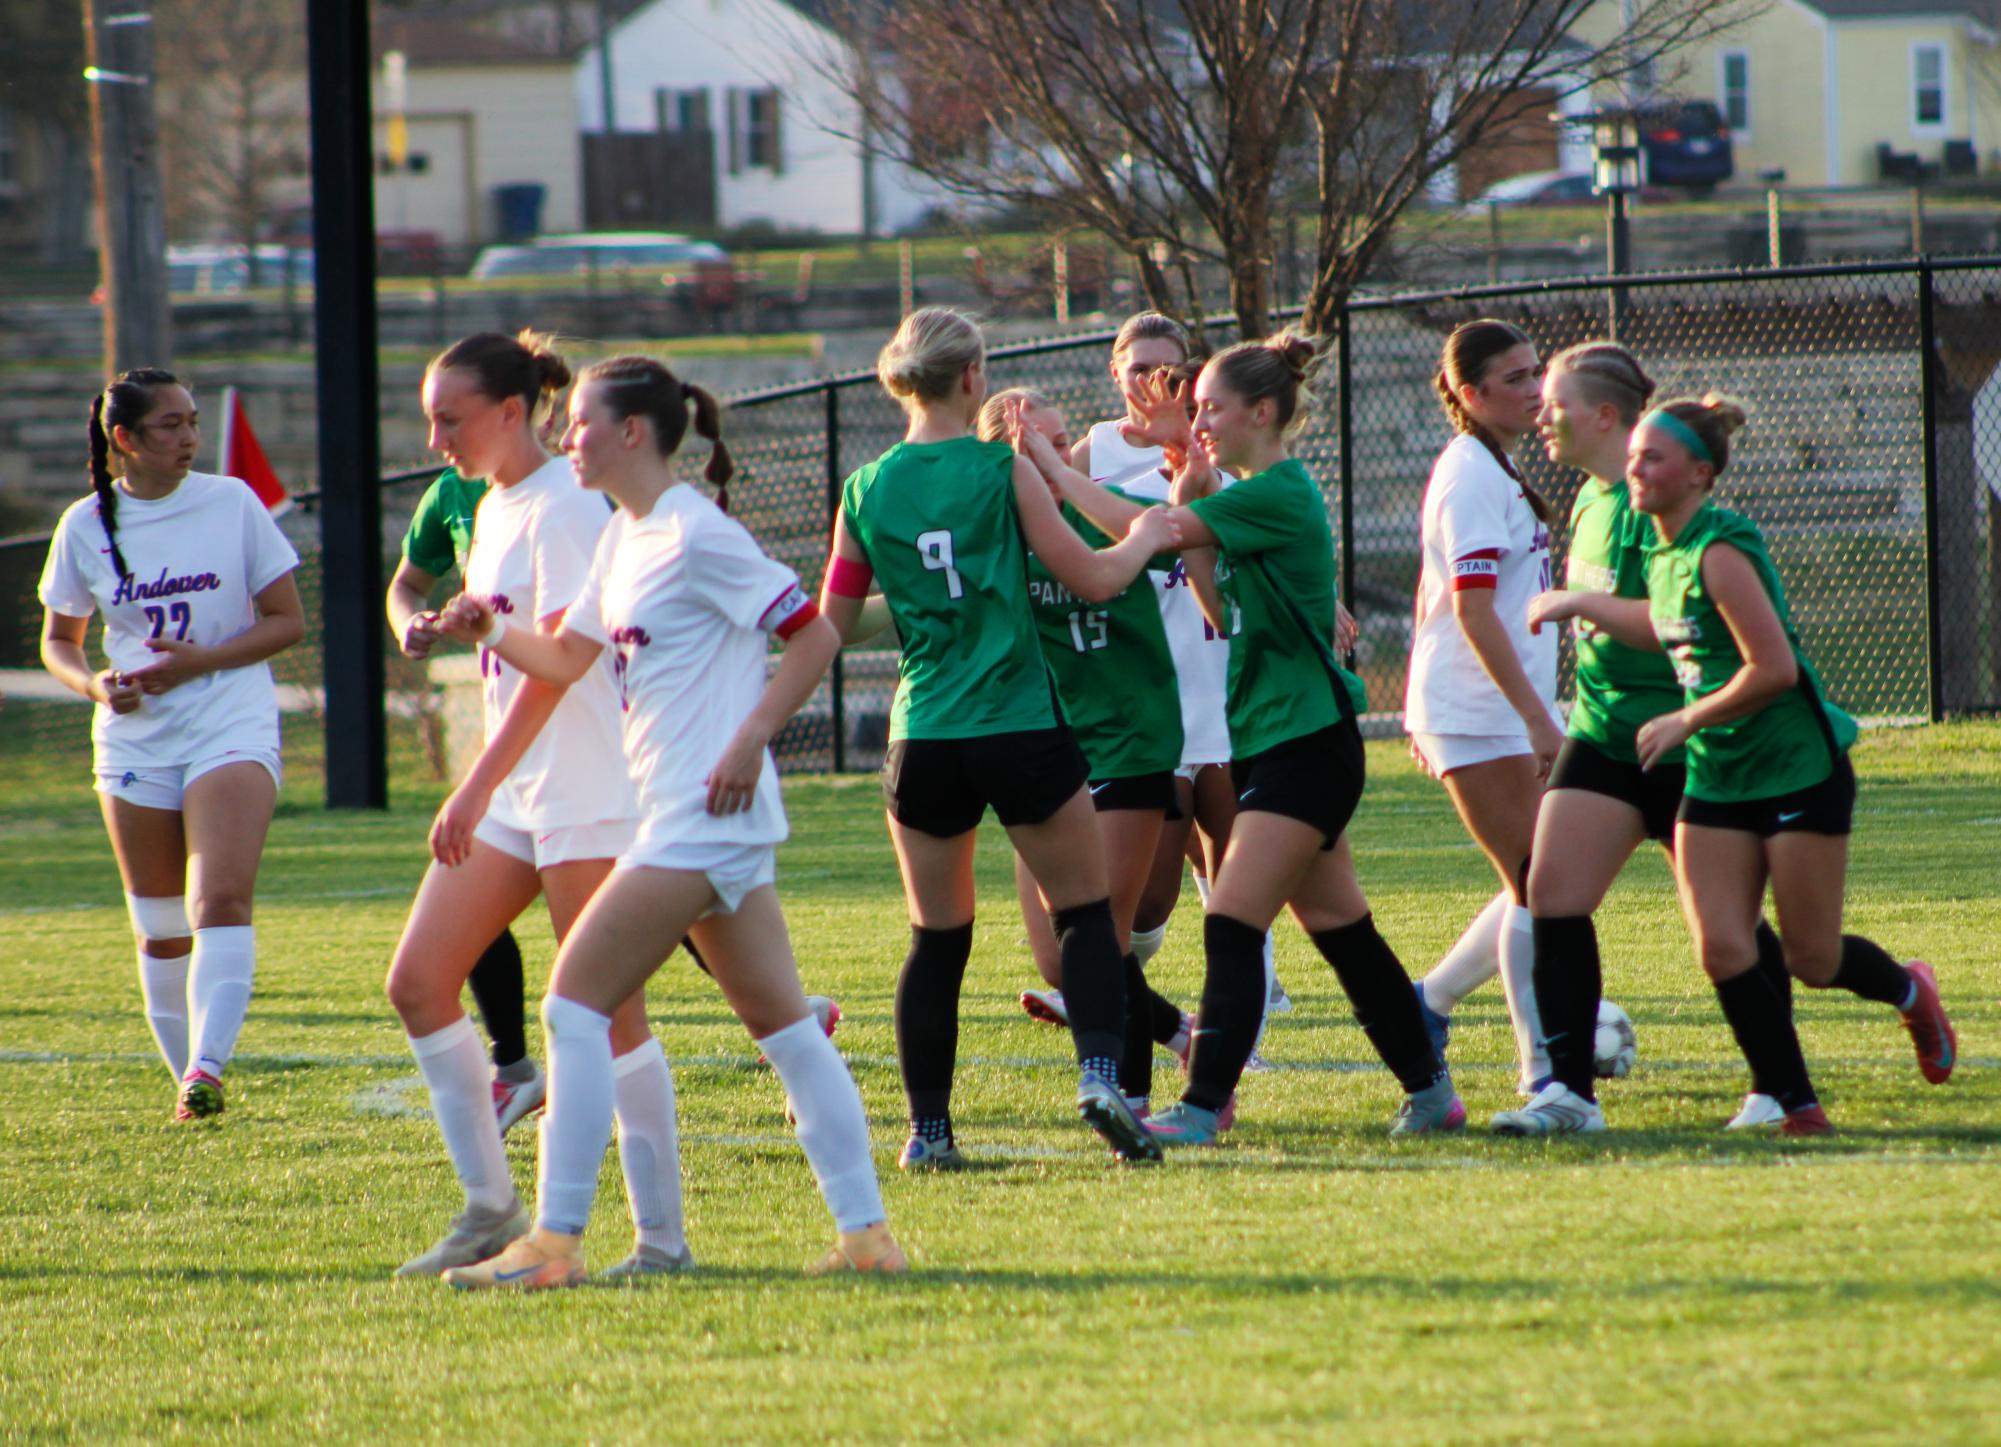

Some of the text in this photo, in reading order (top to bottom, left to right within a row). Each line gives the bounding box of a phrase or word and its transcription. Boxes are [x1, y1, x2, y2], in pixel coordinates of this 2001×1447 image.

[915, 528, 965, 600] 9
[1455, 560, 1493, 574] PTAIN
[111, 566, 222, 607] Andover
[1067, 609, 1111, 653] 15
